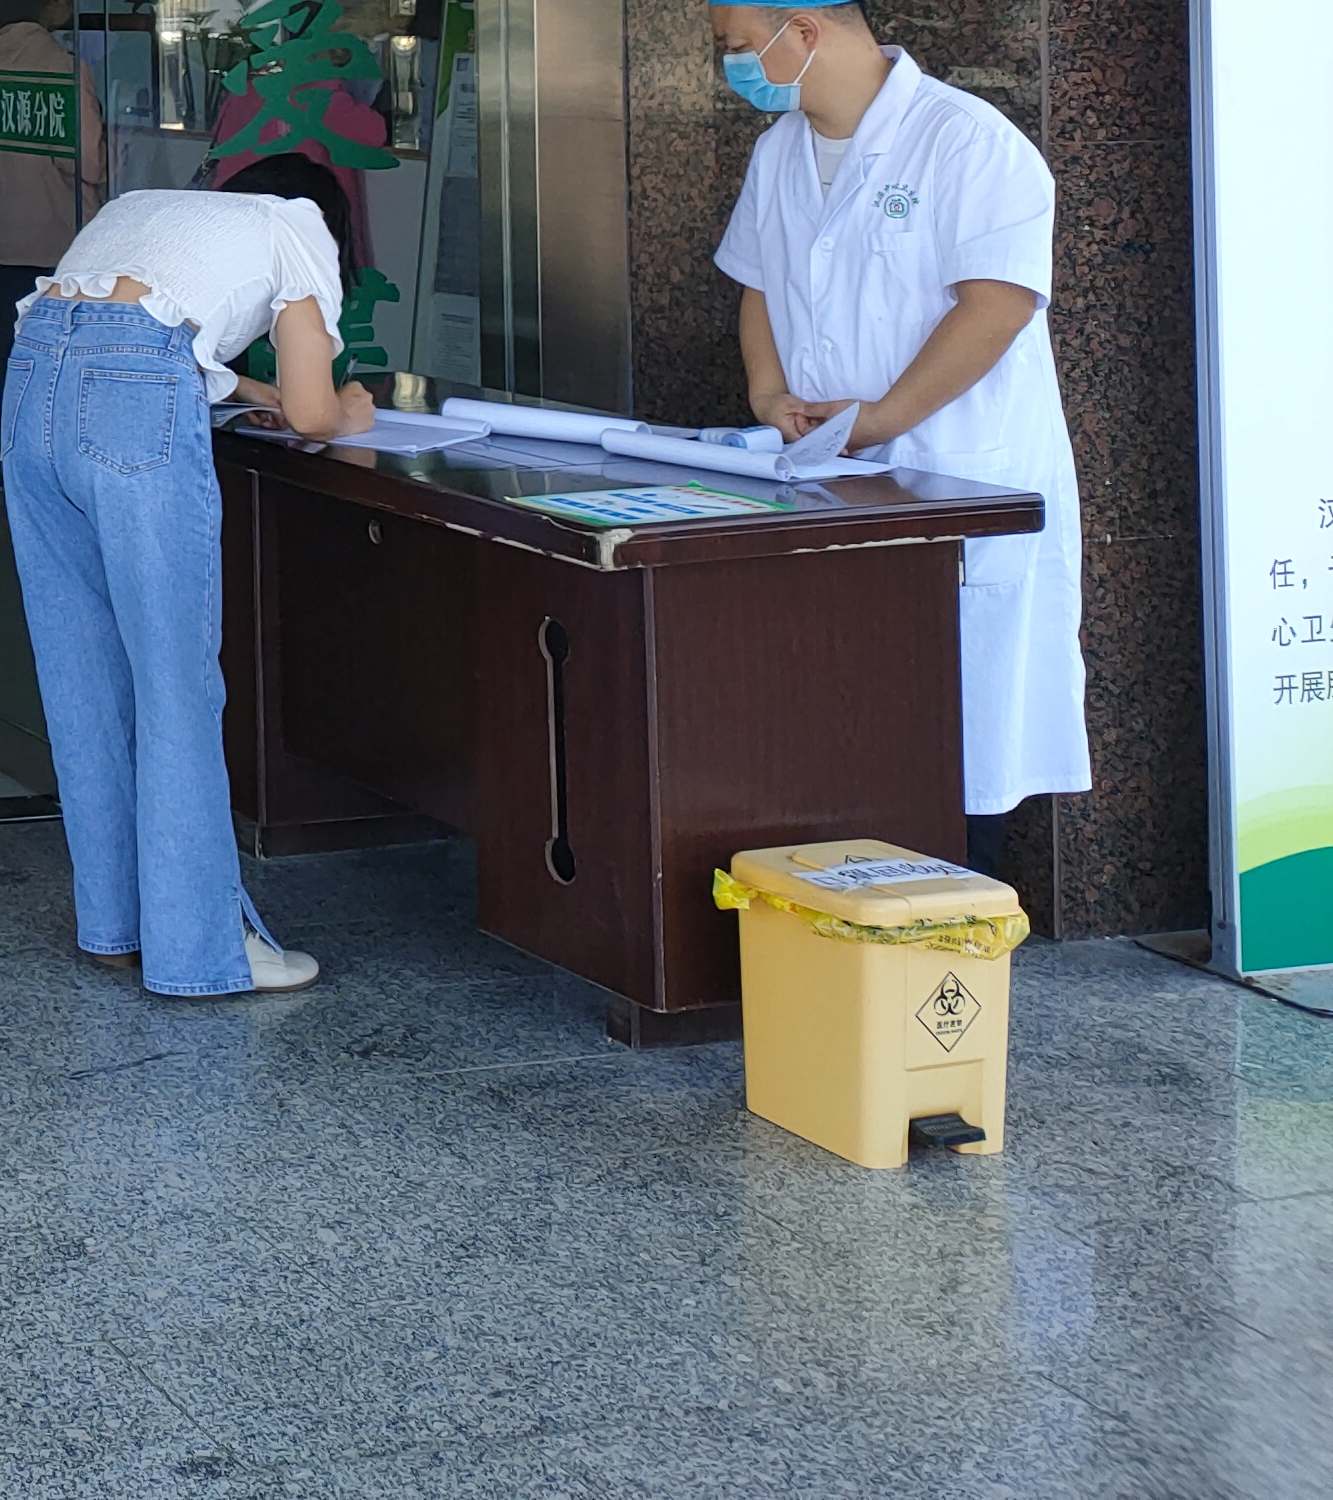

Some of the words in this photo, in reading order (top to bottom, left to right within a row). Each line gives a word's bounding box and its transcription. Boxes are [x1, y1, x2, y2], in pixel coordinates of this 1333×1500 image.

[1269, 555, 1333, 590] 任，
[1271, 614, 1333, 648] 心卫
[1273, 670, 1333, 706] 开展
